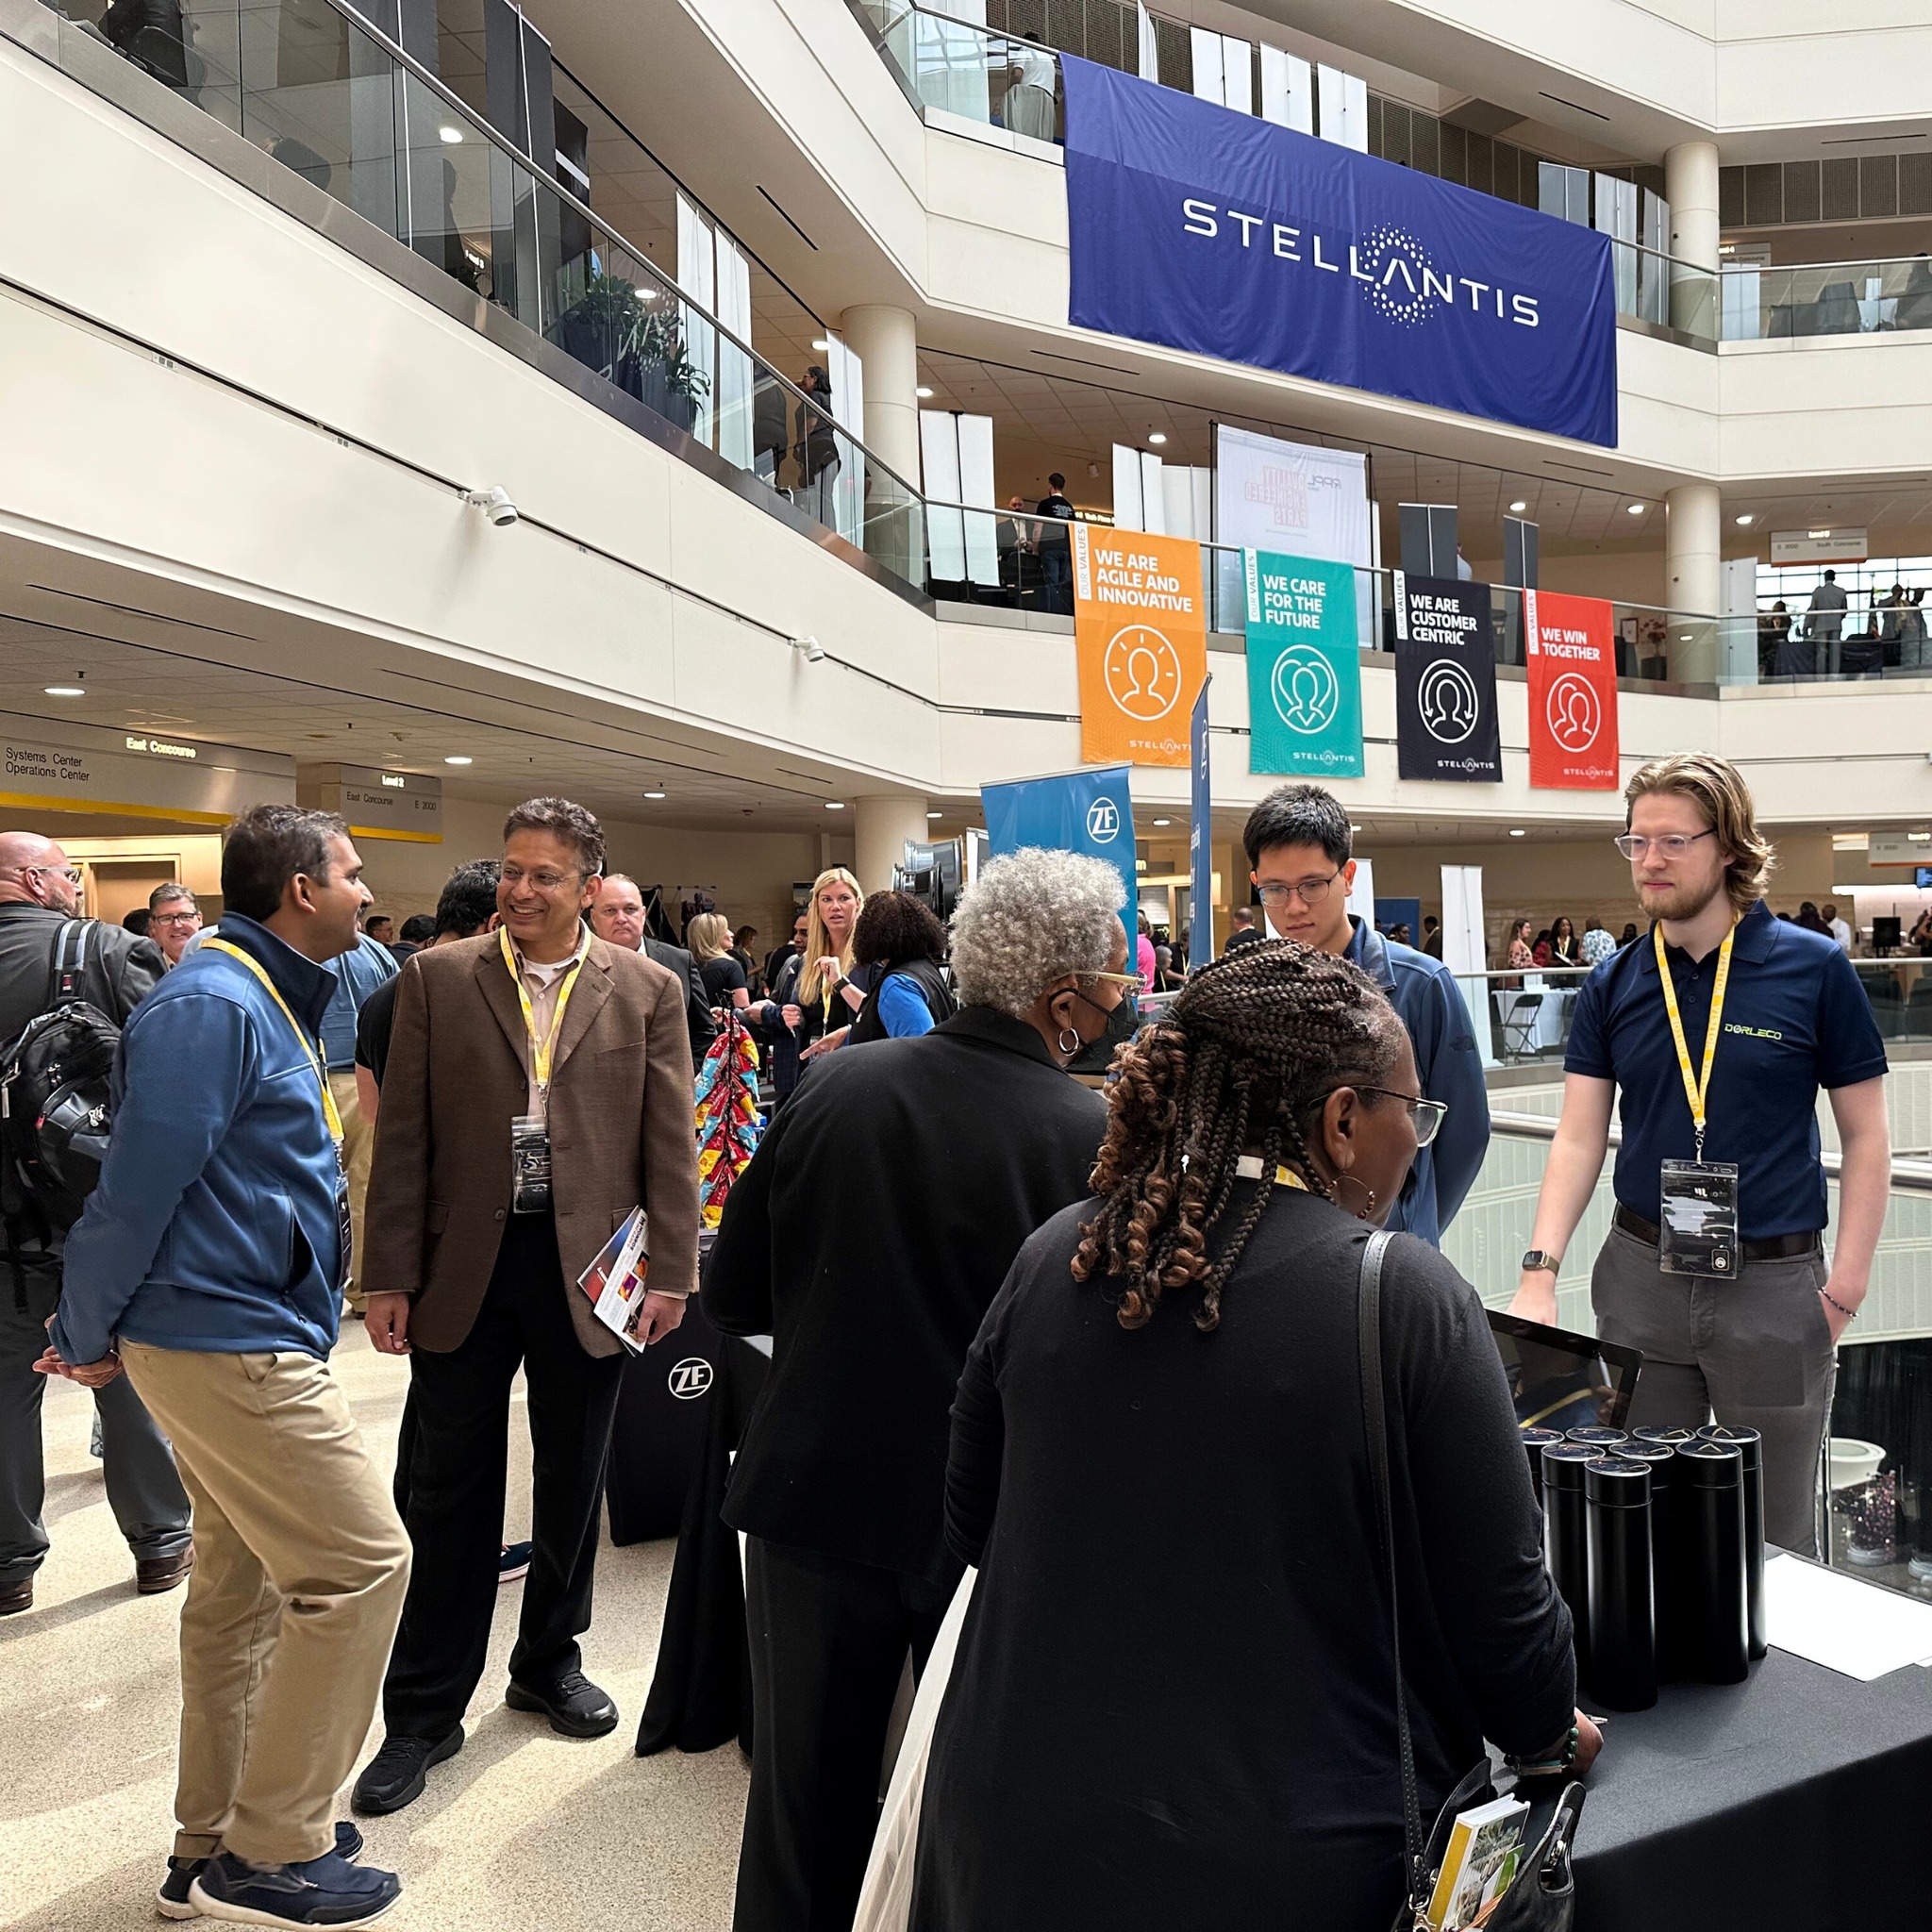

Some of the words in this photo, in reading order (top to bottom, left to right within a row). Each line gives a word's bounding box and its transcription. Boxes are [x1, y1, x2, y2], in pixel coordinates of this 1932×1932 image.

[1182, 197, 1540, 328] STELLANTIS
[1077, 528, 1089, 570] VALUES
[1094, 548, 1124, 568] WE
[1126, 554, 1158, 573] ARE
[1080, 573, 1090, 595] OUR
[1096, 568, 1142, 589] AGILE
[1145, 575, 1180, 593] AND
[1247, 556, 1257, 594] VALUES
[1262, 574, 1288, 591] WE
[1290, 577, 1326, 597] CARE
[1097, 586, 1193, 613] INNOVATIVE
[1264, 591, 1293, 609] FOR
[1294, 595, 1323, 613] THE
[1396, 576, 1406, 614] VALUES
[1409, 593, 1433, 610] WE
[1434, 597, 1460, 613] ARE
[1250, 596, 1258, 618] OUR
[1528, 595, 1537, 632] VALUES
[1265, 608, 1321, 629] FUTURE
[1398, 615, 1407, 635] OUR
[1410, 610, 1478, 632] CUSTOMER
[1411, 626, 1465, 645] CENTRIC
[1541, 627, 1562, 642] WE
[1562, 629, 1588, 643] WIN
[1541, 641, 1601, 661] TOGETHER
[6, 746, 47, 763] Systems
[53, 753, 83, 767] Center
[125, 737, 147, 752] East
[149, 741, 197, 758] Concourse
[1128, 739, 1192, 752] STELLANTI
[1292, 751, 1356, 763] STELLANTIS
[1437, 759, 1495, 770] STELLANTIS
[6, 760, 57, 778] Operations
[59, 769, 91, 782] Center
[1562, 767, 1614, 777] STELLANTIS
[346, 791, 360, 802] East
[363, 793, 393, 806] Concourse
[414, 800, 420, 809] E
[422, 801, 437, 810] 2000
[1089, 804, 1118, 837] ZF
[1715, 952, 1731, 996] VISITOR
[1706, 1006, 1721, 1050] VISITOR
[1724, 1023, 1782, 1041] DORLECO
[671, 1365, 710, 1394] ZF
